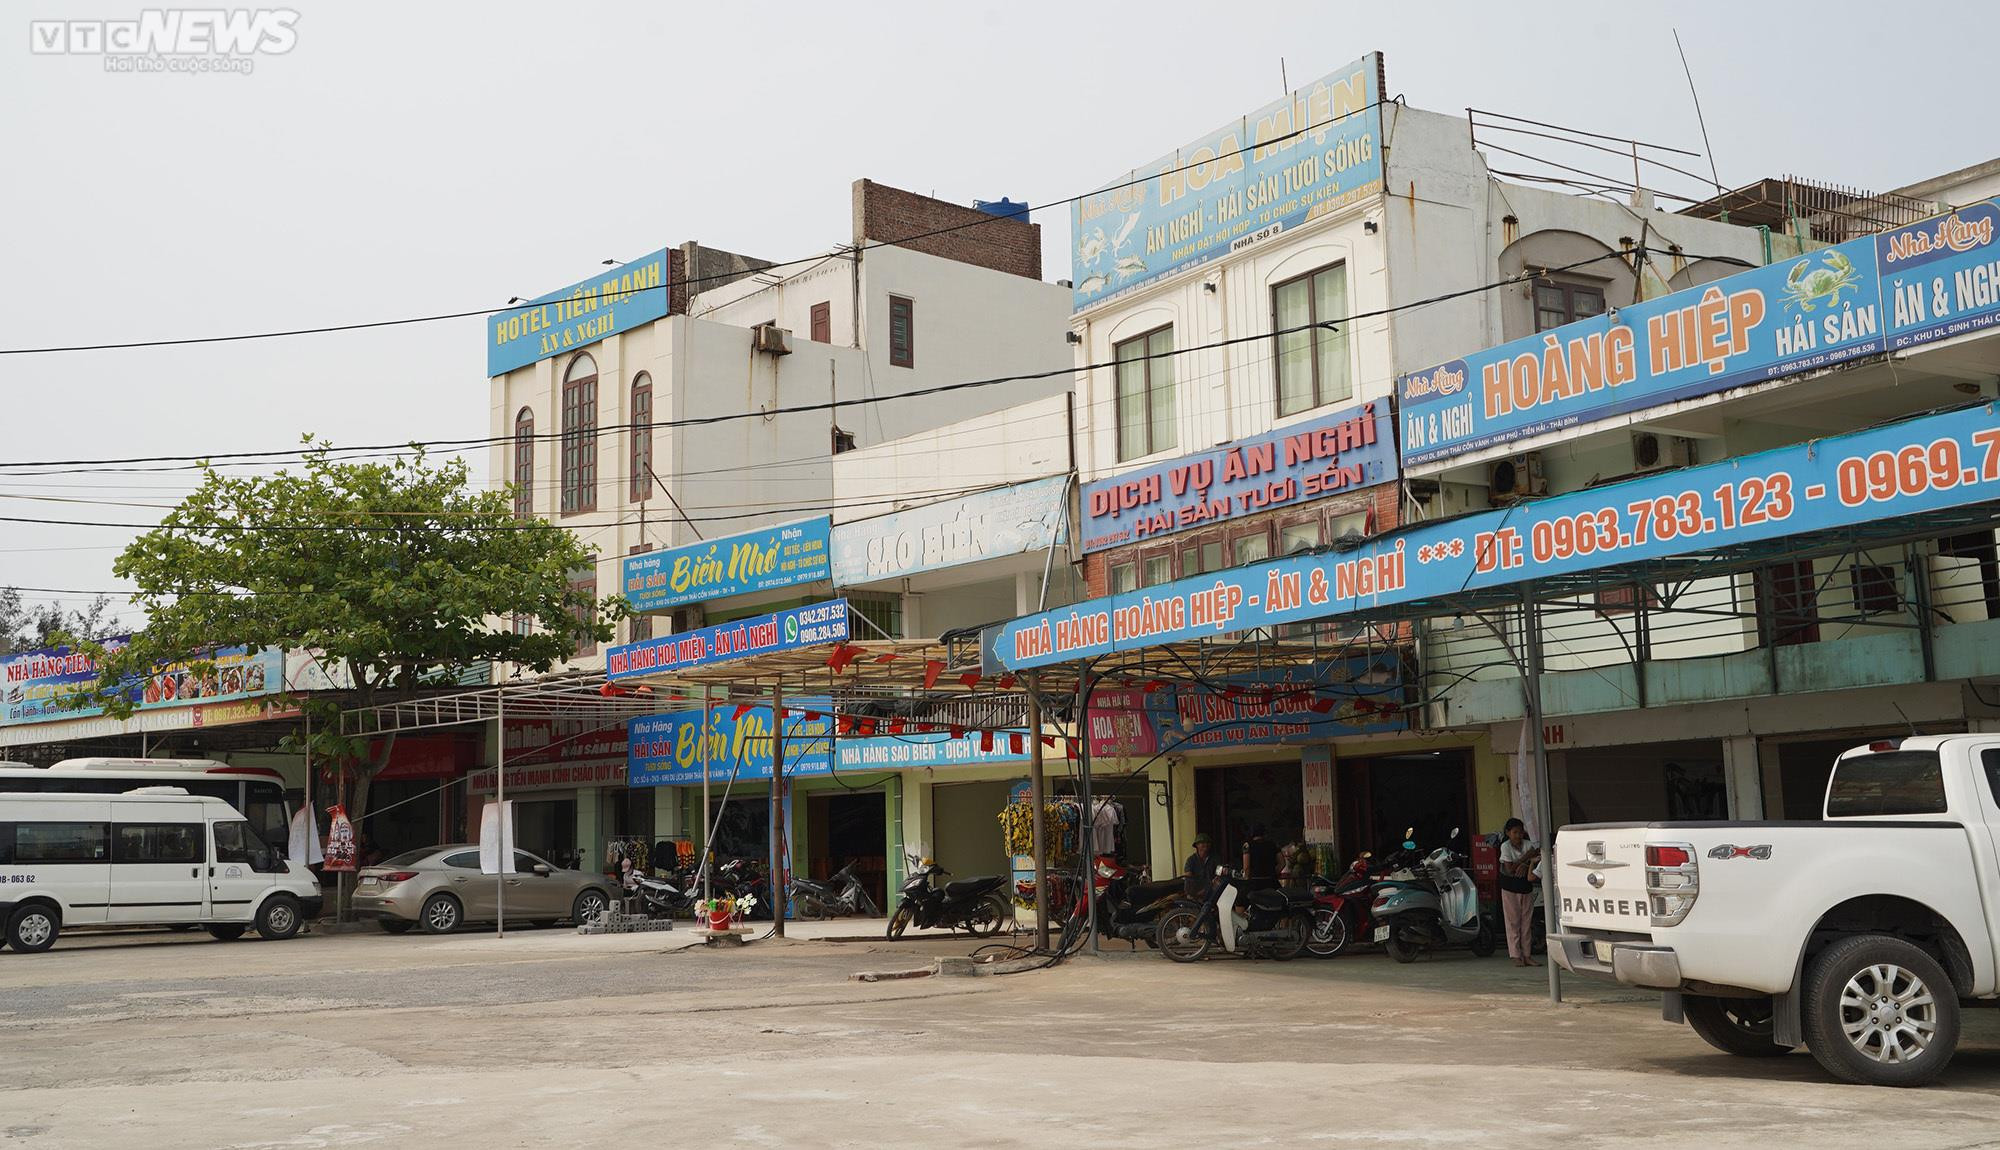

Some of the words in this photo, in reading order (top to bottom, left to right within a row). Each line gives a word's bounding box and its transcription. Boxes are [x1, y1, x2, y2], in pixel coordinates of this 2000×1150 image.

[1158, 131, 1246, 207] HOA
[1253, 69, 1367, 164] MIỆN
[1146, 224, 1166, 257] ĂN
[1168, 199, 1204, 245] NGHỈ
[1217, 186, 1243, 225] HẢI
[1246, 170, 1279, 212] SẢN
[1282, 154, 1320, 196] TƯƠI
[1324, 133, 1373, 178] SỐNG
[1316, 181, 1340, 200] KIỆN
[1272, 225, 1279, 234] 8
[1887, 230, 1933, 262] Nhà
[1934, 214, 1993, 252] Hàng
[497, 304, 551, 345] HOTEL
[555, 285, 597, 324] TIẾN
[602, 261, 660, 307] MẠNH
[1893, 278, 1926, 329] ĂN
[1932, 277, 1949, 318] &
[1775, 314, 1817, 357] HẢI
[1823, 300, 1876, 345] SẢN
[1914, 331, 1932, 343] KHU
[1934, 327, 1947, 338] DL
[1948, 321, 1970, 335] SINH
[1971, 316, 1992, 330] THÁI
[1482, 325, 1636, 421] HOÀNG
[1648, 286, 1767, 376] HIỆP
[1404, 375, 1431, 400] Nhà
[1429, 365, 1464, 396] Hàng
[1407, 411, 1425, 450] ĂN
[1428, 413, 1438, 445] &
[1441, 391, 1474, 441] NGHỈ
[1493, 435, 1506, 444] NAM
[1089, 473, 1162, 519] DỊCH
[1168, 459, 1214, 500] VỤ
[1222, 442, 1275, 483] ĂN
[1284, 402, 1378, 467] NGHỈ
[1179, 494, 1232, 526] SẢN
[1238, 475, 1297, 511] TƯƠI
[781, 527, 802, 541] Nhận
[629, 560, 643, 571] Nhà
[644, 558, 661, 569] hàng
[670, 543, 724, 593] Biển
[727, 537, 781, 585] Nhớ
[1014, 618, 1053, 661] NHÀ
[1055, 611, 1109, 653] HÀNG
[1112, 595, 1185, 642] HOÀNG
[1188, 580, 1243, 631] HIỆP
[1264, 568, 1302, 614] ĂN
[1308, 566, 1329, 605] &
[1335, 538, 1407, 601] NGHỈ
[1474, 526, 1525, 575] ĐT:
[1531, 471, 1795, 564] 0963.783.123
[628, 571, 645, 592] HẢI
[646, 569, 667, 589] SẢN
[799, 603, 845, 626] 0342.297.532
[610, 648, 629, 675] NHÀ
[630, 645, 656, 672] HÀNG
[657, 642, 677, 667] HOA
[679, 634, 707, 665] MIỆN
[715, 629, 730, 657] ĂN
[732, 624, 748, 653] VÀ
[750, 614, 779, 648] NGHỈ
[800, 621, 846, 644] 0906.284.506
[7, 659, 30, 682] NHÀ
[31, 655, 62, 678] HÀNG
[1096, 694, 1112, 708] NHÀ
[1177, 686, 1204, 726] HẢI
[1205, 688, 1237, 723] SẢN
[634, 721, 650, 733] Nhà
[651, 721, 673, 735] Hàng
[675, 712, 727, 769] Biển
[1092, 715, 1115, 740] HOA
[1191, 730, 1222, 745] DỊCH
[1226, 728, 1245, 744] VỤ
[1248, 723, 1269, 739] ĂN
[634, 736, 649, 759] HẢI
[652, 734, 672, 758] SẢN
[842, 746, 861, 765] NHÀ
[863, 744, 889, 764] HÀNG
[891, 743, 910, 763] SAO
[912, 737, 936, 761] BIỂN
[946, 739, 970, 763] DỊCH
[473, 774, 488, 789] NHÀ
[510, 768, 526, 786] TIẾN
[572, 764, 593, 782] CHÀO
[657, 759, 672, 772] SỐNG
[26, 874, 36, 883] 62
[1563, 897, 1648, 917] RANGER
